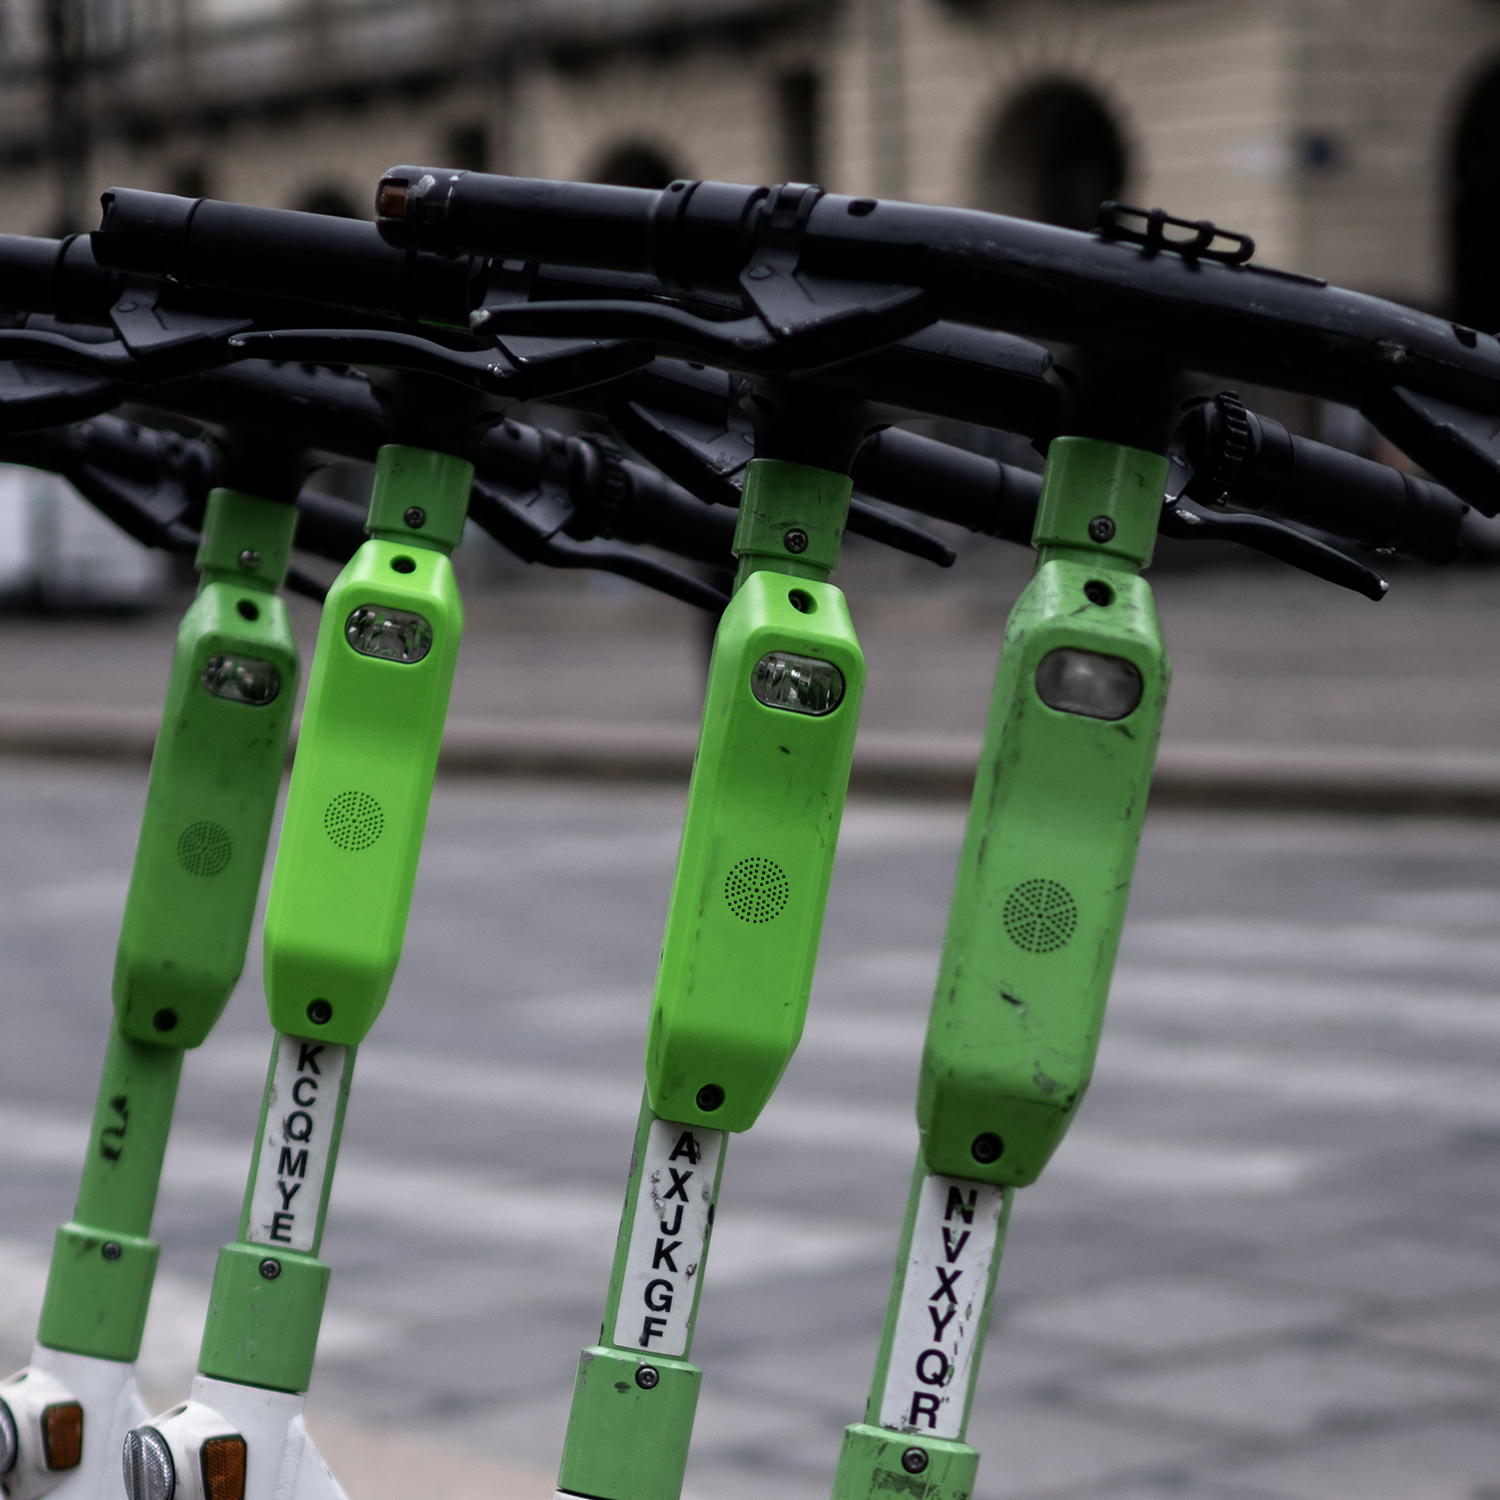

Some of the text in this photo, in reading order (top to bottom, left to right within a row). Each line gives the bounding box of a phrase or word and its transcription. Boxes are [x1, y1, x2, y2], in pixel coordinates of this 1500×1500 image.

[269, 1043, 325, 1243] KCQMYE
[640, 1131, 697, 1347] AXJKGF
[908, 1186, 978, 1429] NVXYQR
